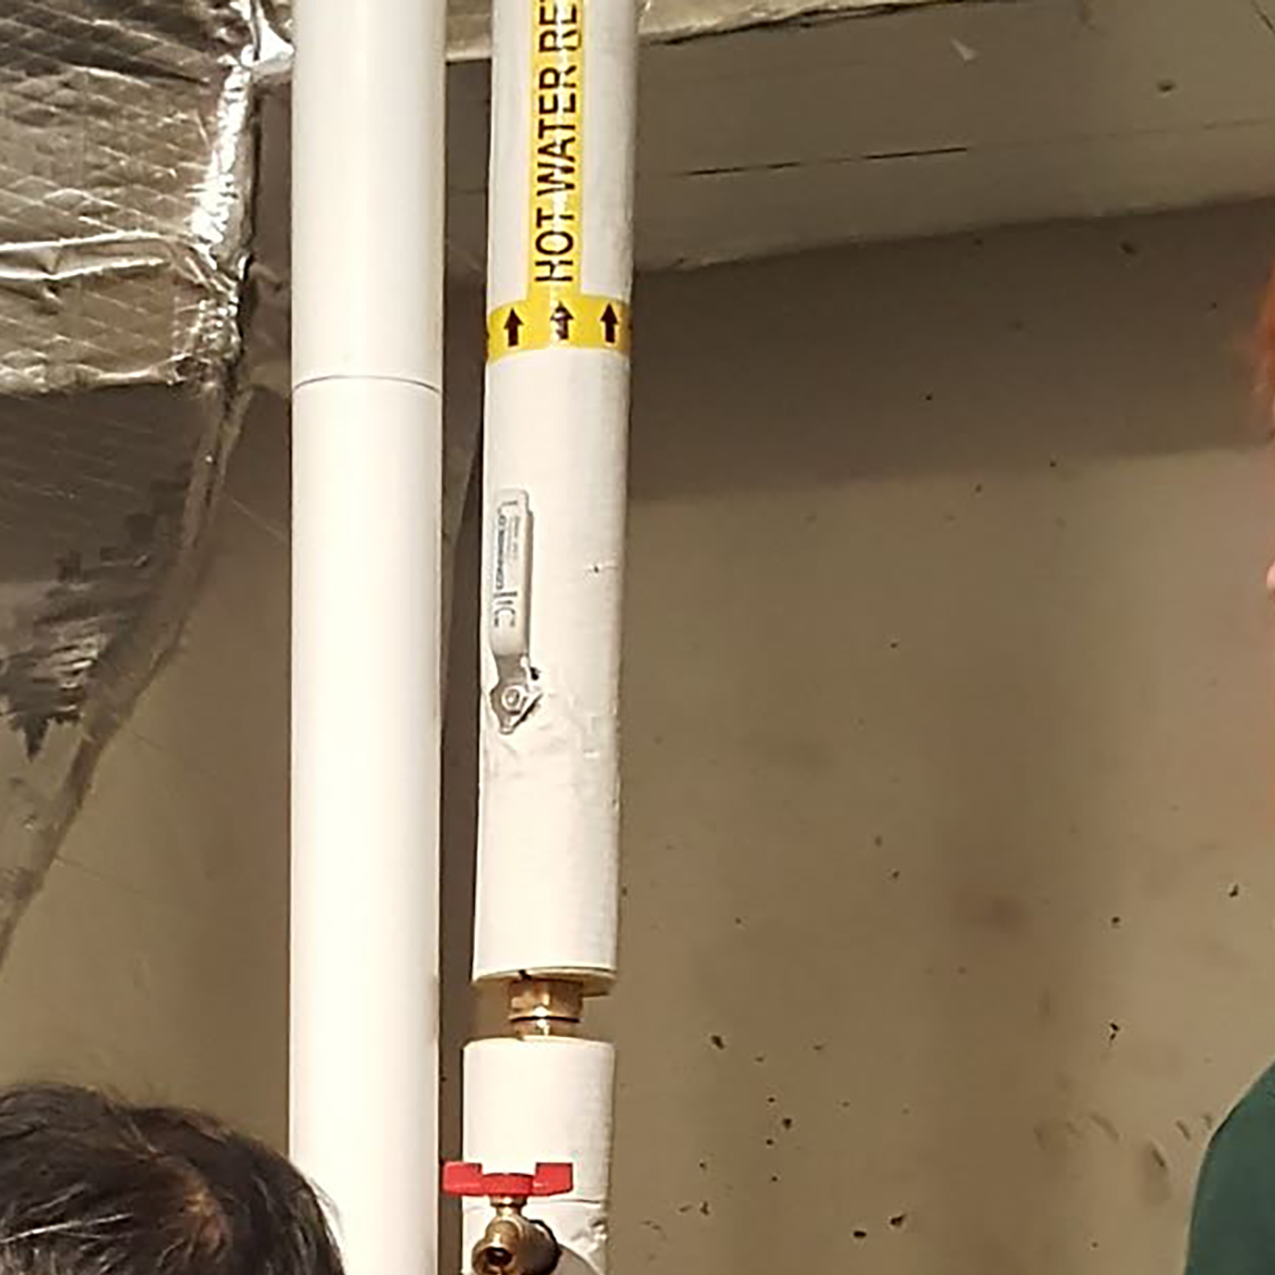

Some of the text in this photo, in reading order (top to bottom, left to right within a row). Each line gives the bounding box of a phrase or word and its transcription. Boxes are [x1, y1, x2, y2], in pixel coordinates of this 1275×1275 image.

[534, 0, 582, 282] HOT WATER RE
